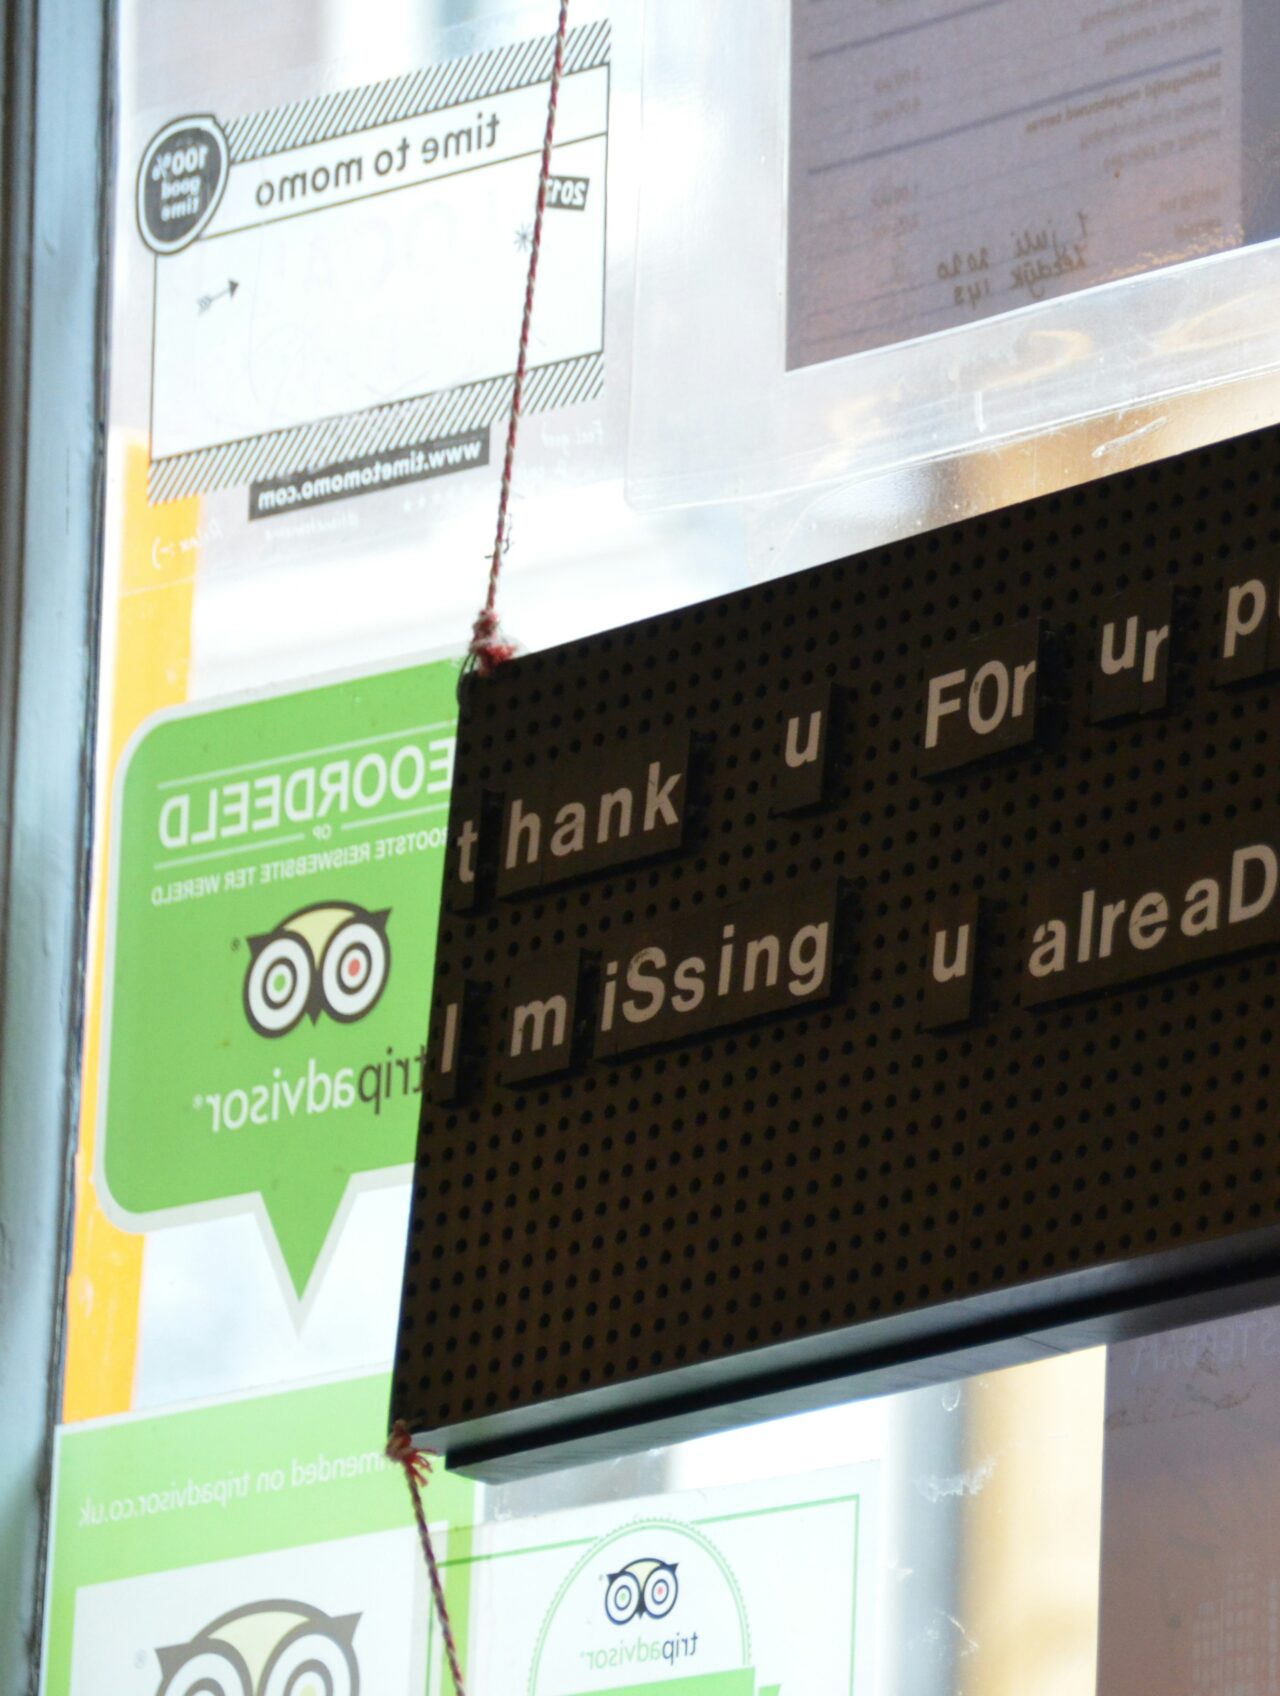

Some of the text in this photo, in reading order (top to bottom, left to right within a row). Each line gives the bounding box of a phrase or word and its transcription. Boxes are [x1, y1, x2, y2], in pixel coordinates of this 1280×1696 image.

[785, 711, 822, 768] u
[1101, 615, 1169, 682] ur
[932, 924, 971, 984] u
